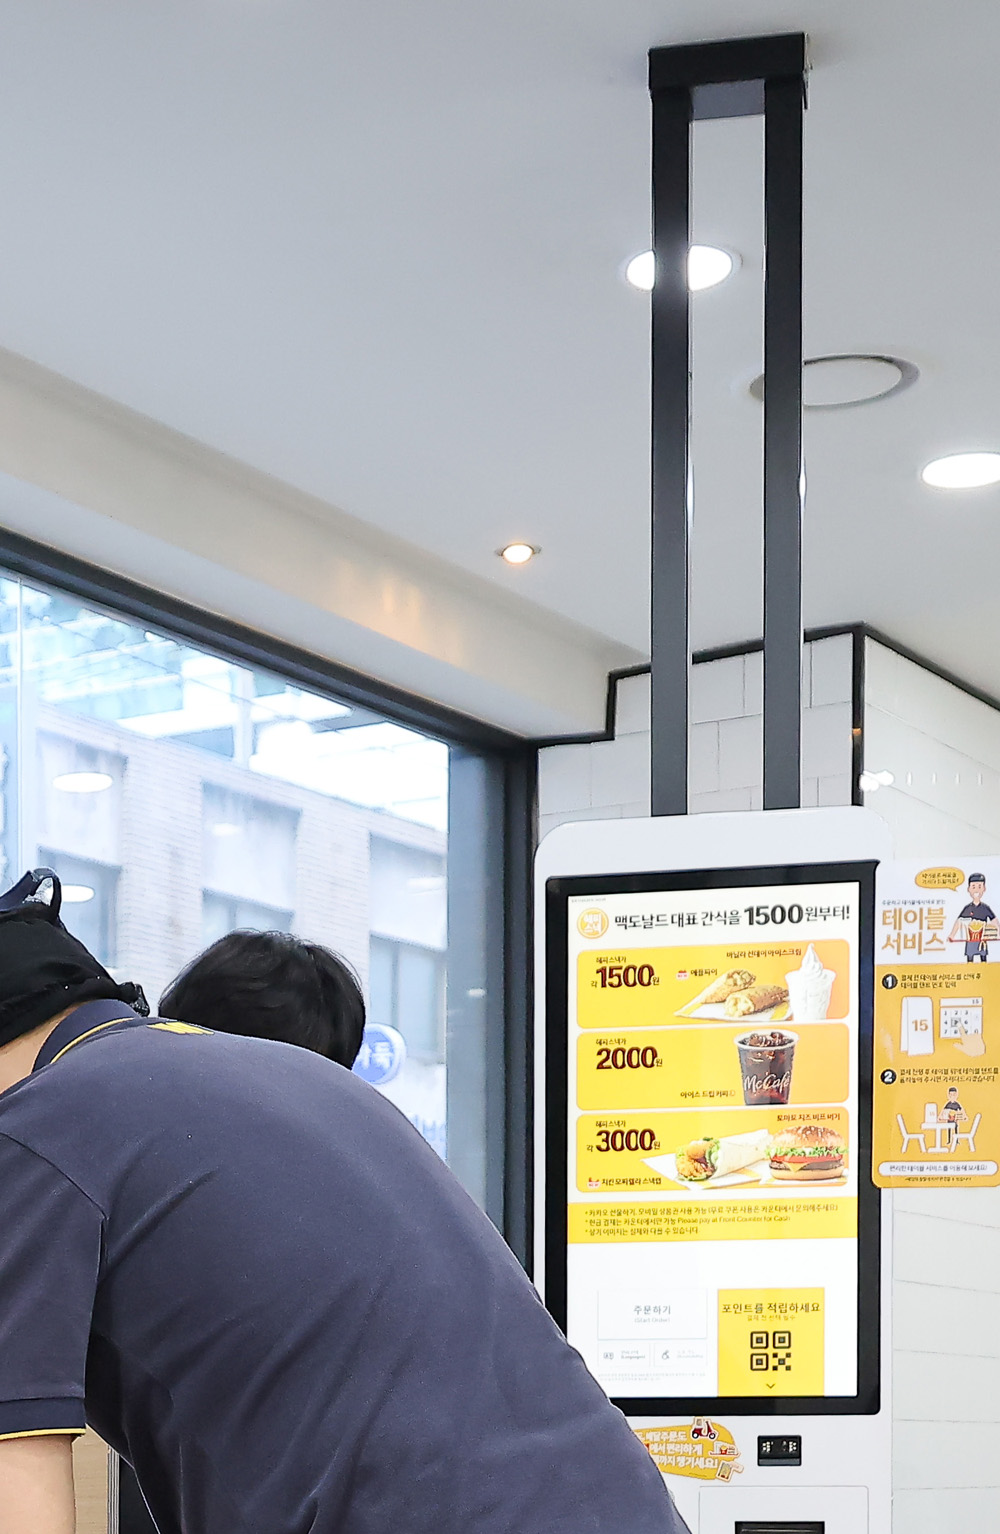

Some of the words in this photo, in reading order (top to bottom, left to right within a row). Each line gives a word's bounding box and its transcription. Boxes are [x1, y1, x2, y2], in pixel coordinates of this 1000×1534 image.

[614, 913, 669, 930] 맥도날드
[671, 912, 698, 928] 대표
[701, 910, 742, 927] 간식을
[882, 907, 946, 930] 테이블
[881, 931, 946, 955] 서비스
[596, 964, 660, 988] 1500원
[912, 1019, 928, 1032] 15
[596, 1045, 663, 1070] 2000원
[595, 1128, 661, 1153] 3000원
[602, 1178, 614, 1186] 치킨
[634, 1305, 672, 1316] 주문하기
[722, 1303, 763, 1315] 포인트를
[767, 1302, 821, 1314] 적립하세요
[667, 1443, 703, 1456] 편리하게
[677, 1456, 719, 1469] 챙기세요!
